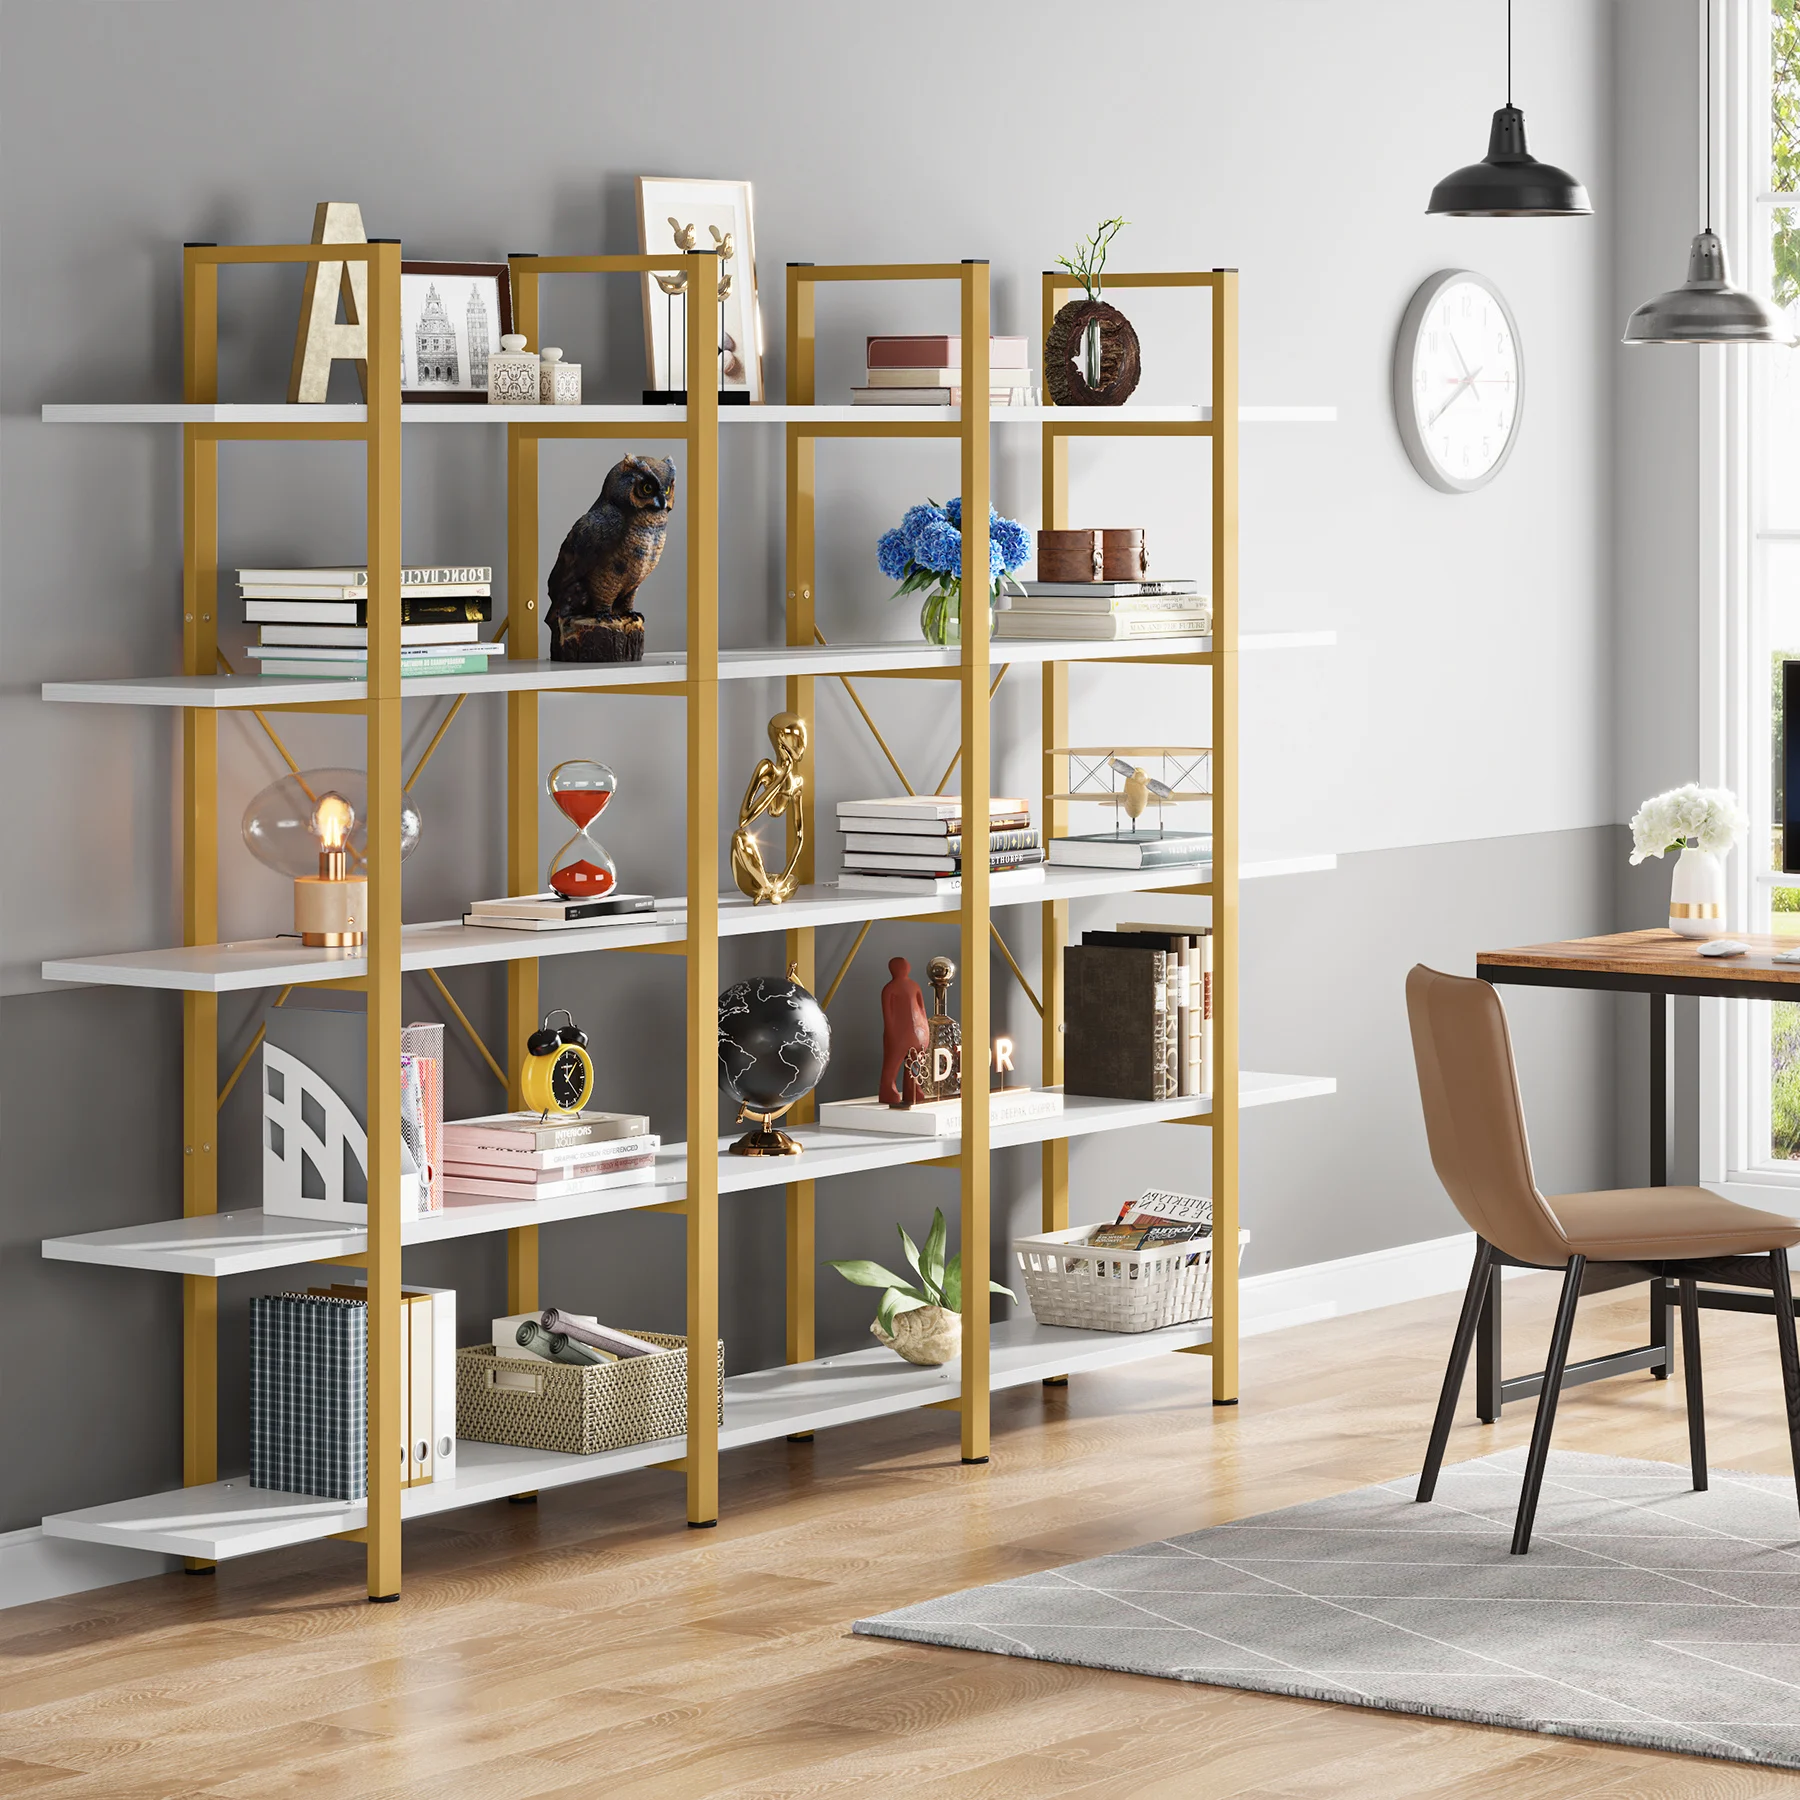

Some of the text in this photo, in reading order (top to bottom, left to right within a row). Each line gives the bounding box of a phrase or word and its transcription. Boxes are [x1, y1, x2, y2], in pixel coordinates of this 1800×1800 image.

[287, 202, 368, 403] A
[1461, 296, 1472, 318] 12
[443, 568, 484, 583] БОРИС
[1179, 621, 1205, 629] FUTURE
[990, 854, 1024, 865] ETHORPE
[934, 1038, 1014, 1082] DR
[1000, 1107, 1027, 1120] DEEPAK
[555, 1126, 592, 1139] INTERIORS
[553, 1153, 578, 1163] GRAPHIC
[602, 1144, 638, 1155] REFERENCED
